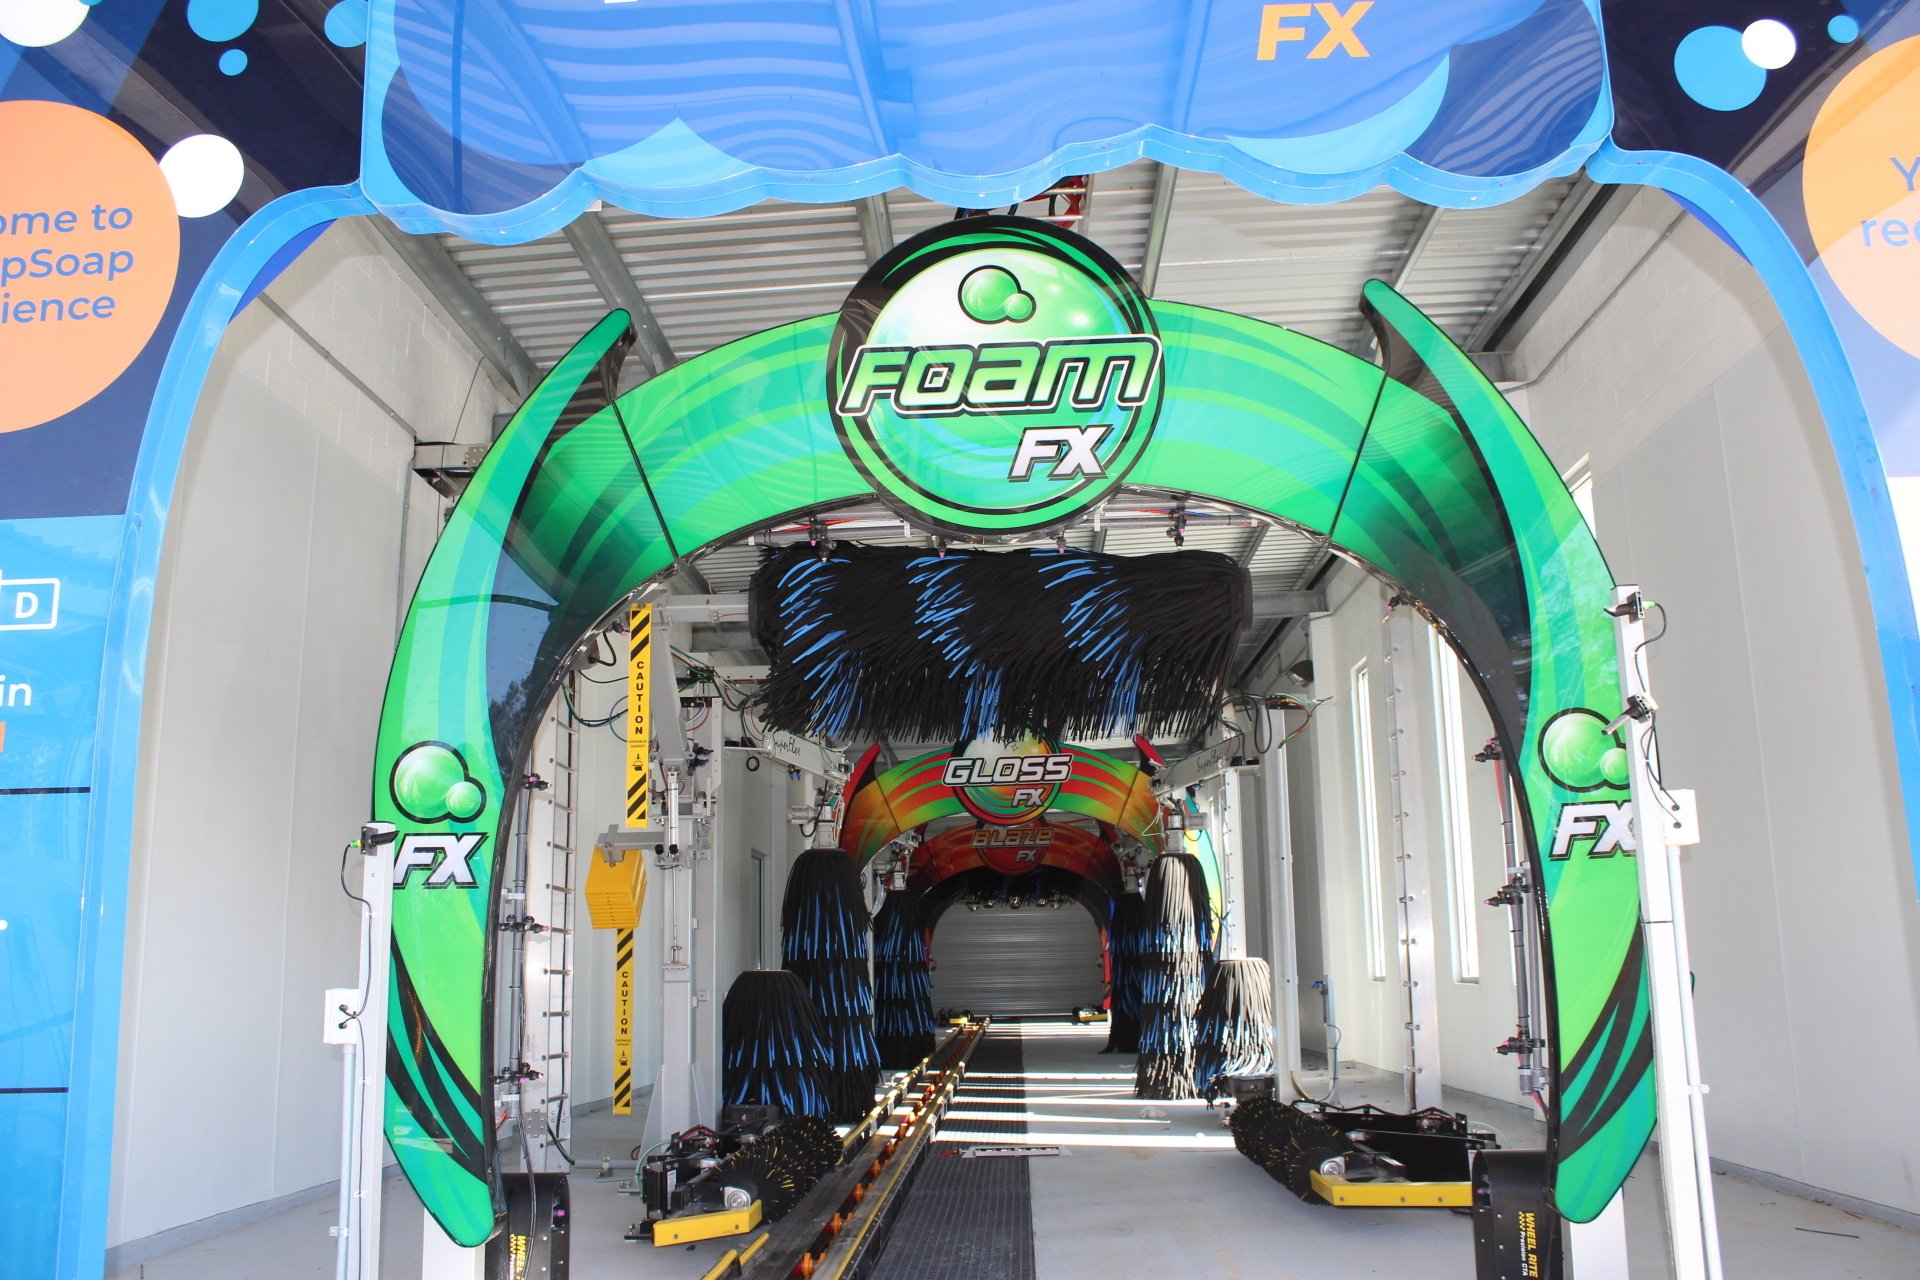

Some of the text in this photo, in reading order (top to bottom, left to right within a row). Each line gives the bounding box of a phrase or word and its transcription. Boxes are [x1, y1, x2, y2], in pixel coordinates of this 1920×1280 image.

[1256, 1, 1376, 61] FX
[91, 204, 133, 231] to
[1861, 219, 1920, 247] re
[0, 249, 134, 287] pSoap
[1, 292, 116, 324] ience
[1008, 425, 1113, 481] FX
[14, 591, 39, 619] D
[635, 661, 645, 735] CAUTION
[943, 754, 1073, 786] GLOSS
[1011, 788, 1046, 808] FX
[1549, 800, 1636, 860] FX
[394, 832, 489, 889] FX
[1016, 850, 1038, 863] FX
[620, 971, 629, 1035] CAUTION
[516, 1235, 527, 1273] WHEEL
[1519, 1231, 1527, 1262] Precision
[1525, 1212, 1539, 1278] WHEEL RITE
